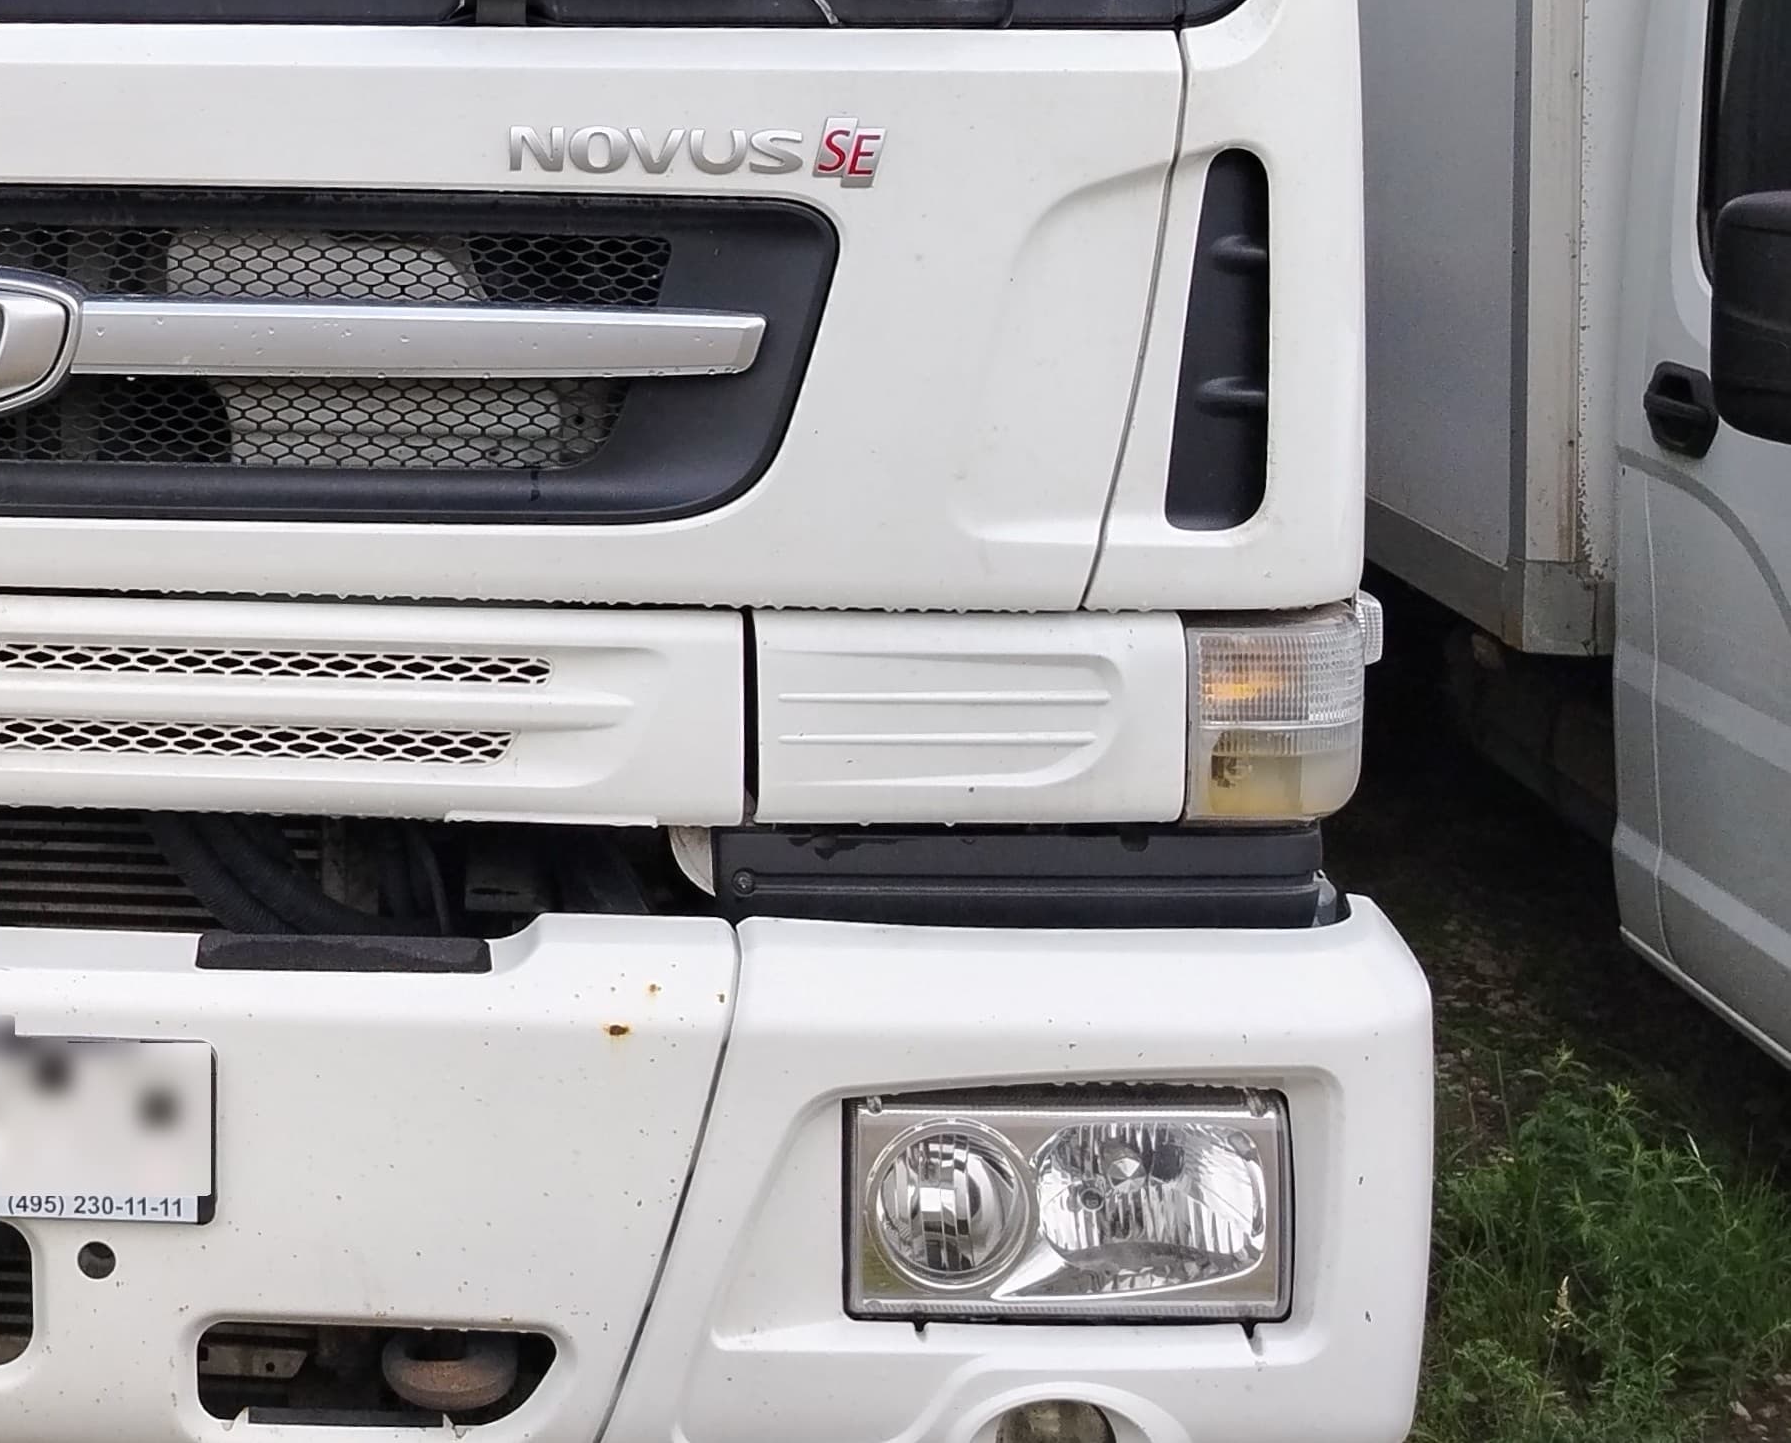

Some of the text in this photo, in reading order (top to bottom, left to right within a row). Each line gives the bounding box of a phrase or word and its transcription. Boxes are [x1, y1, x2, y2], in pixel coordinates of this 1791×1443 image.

[509, 125, 883, 177] NOVUS SE
[7, 1195, 65, 1216] (495)
[73, 1195, 182, 1218] 230-11-11
